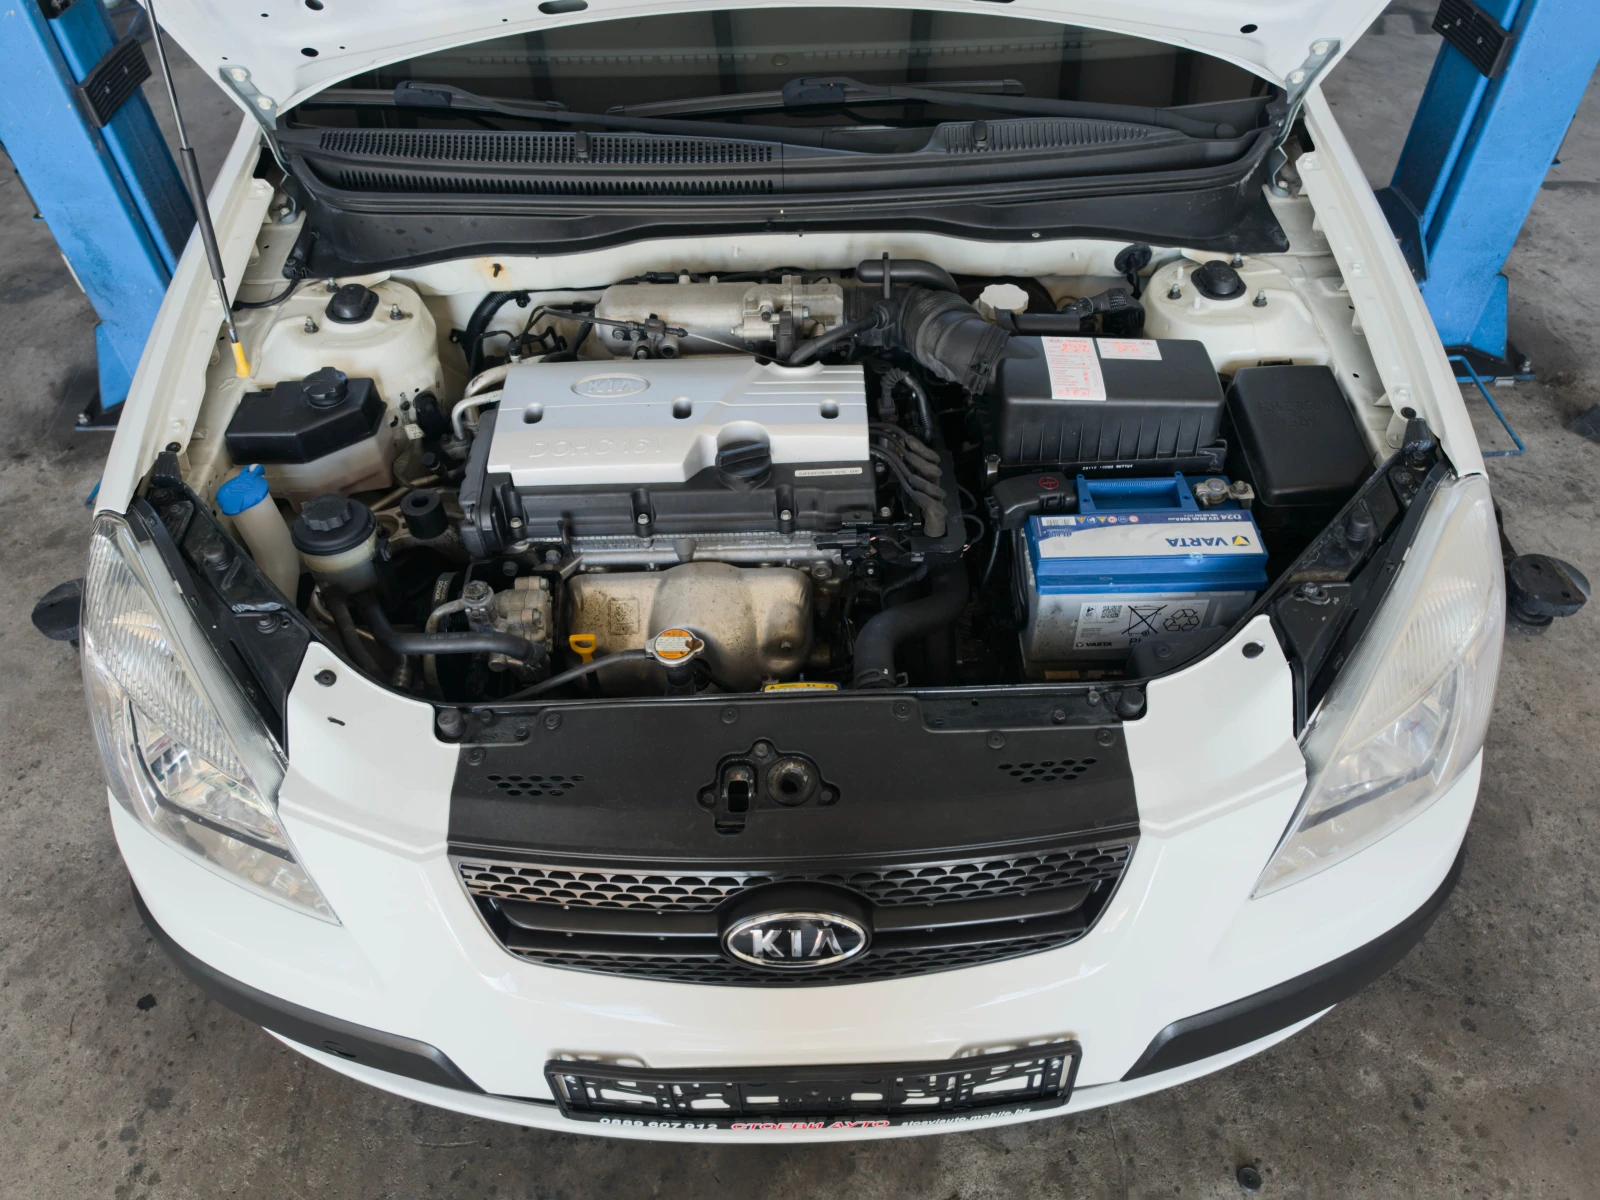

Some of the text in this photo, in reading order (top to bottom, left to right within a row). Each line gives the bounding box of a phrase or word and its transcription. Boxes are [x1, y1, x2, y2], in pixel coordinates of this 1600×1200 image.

[586, 379, 635, 393] KIA
[529, 437, 667, 458] DOHC 16V
[1164, 537, 1229, 548] VARTA
[750, 927, 845, 958] KIA
[599, 1117, 644, 1127] 0889
[647, 1121, 682, 1129] 607
